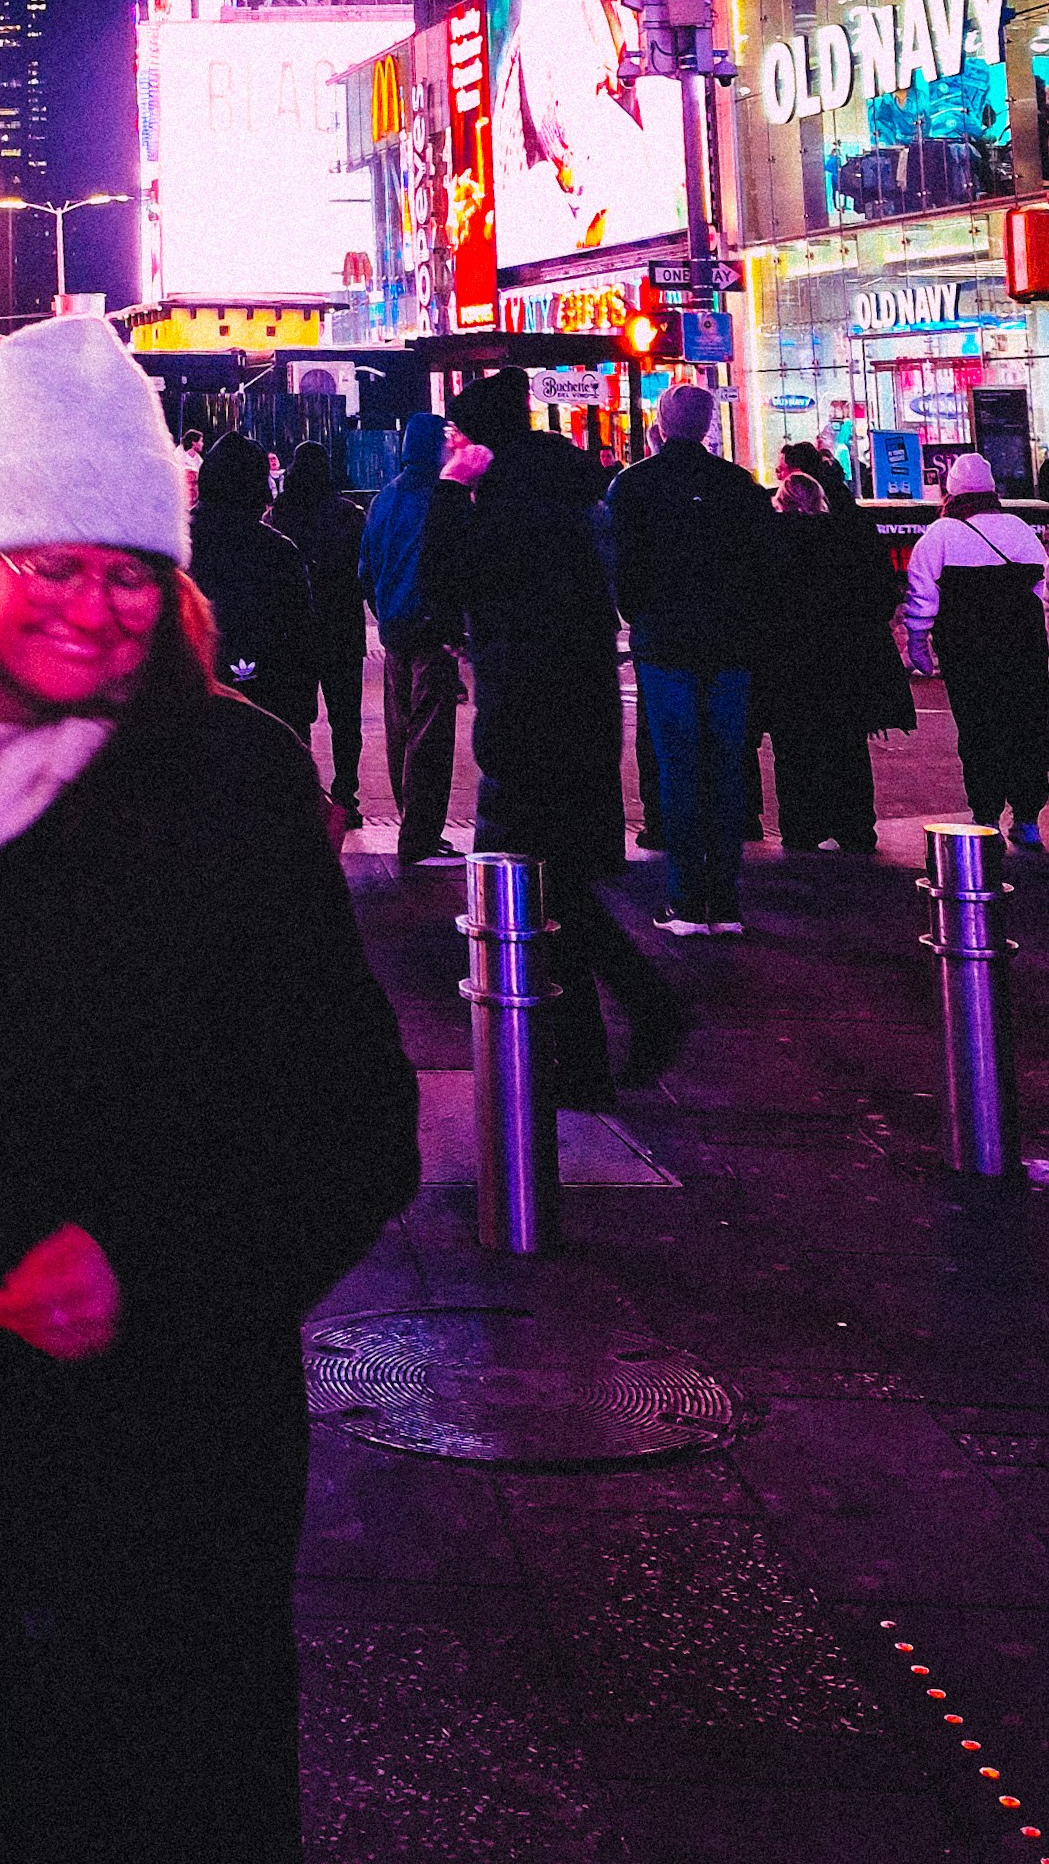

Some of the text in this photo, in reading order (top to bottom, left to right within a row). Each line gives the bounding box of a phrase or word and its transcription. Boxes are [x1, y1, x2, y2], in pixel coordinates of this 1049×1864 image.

[762, 24, 853, 125] OLD
[663, 269, 732, 282] ONE AY
[856, 283, 957, 330] OLD NAVY
